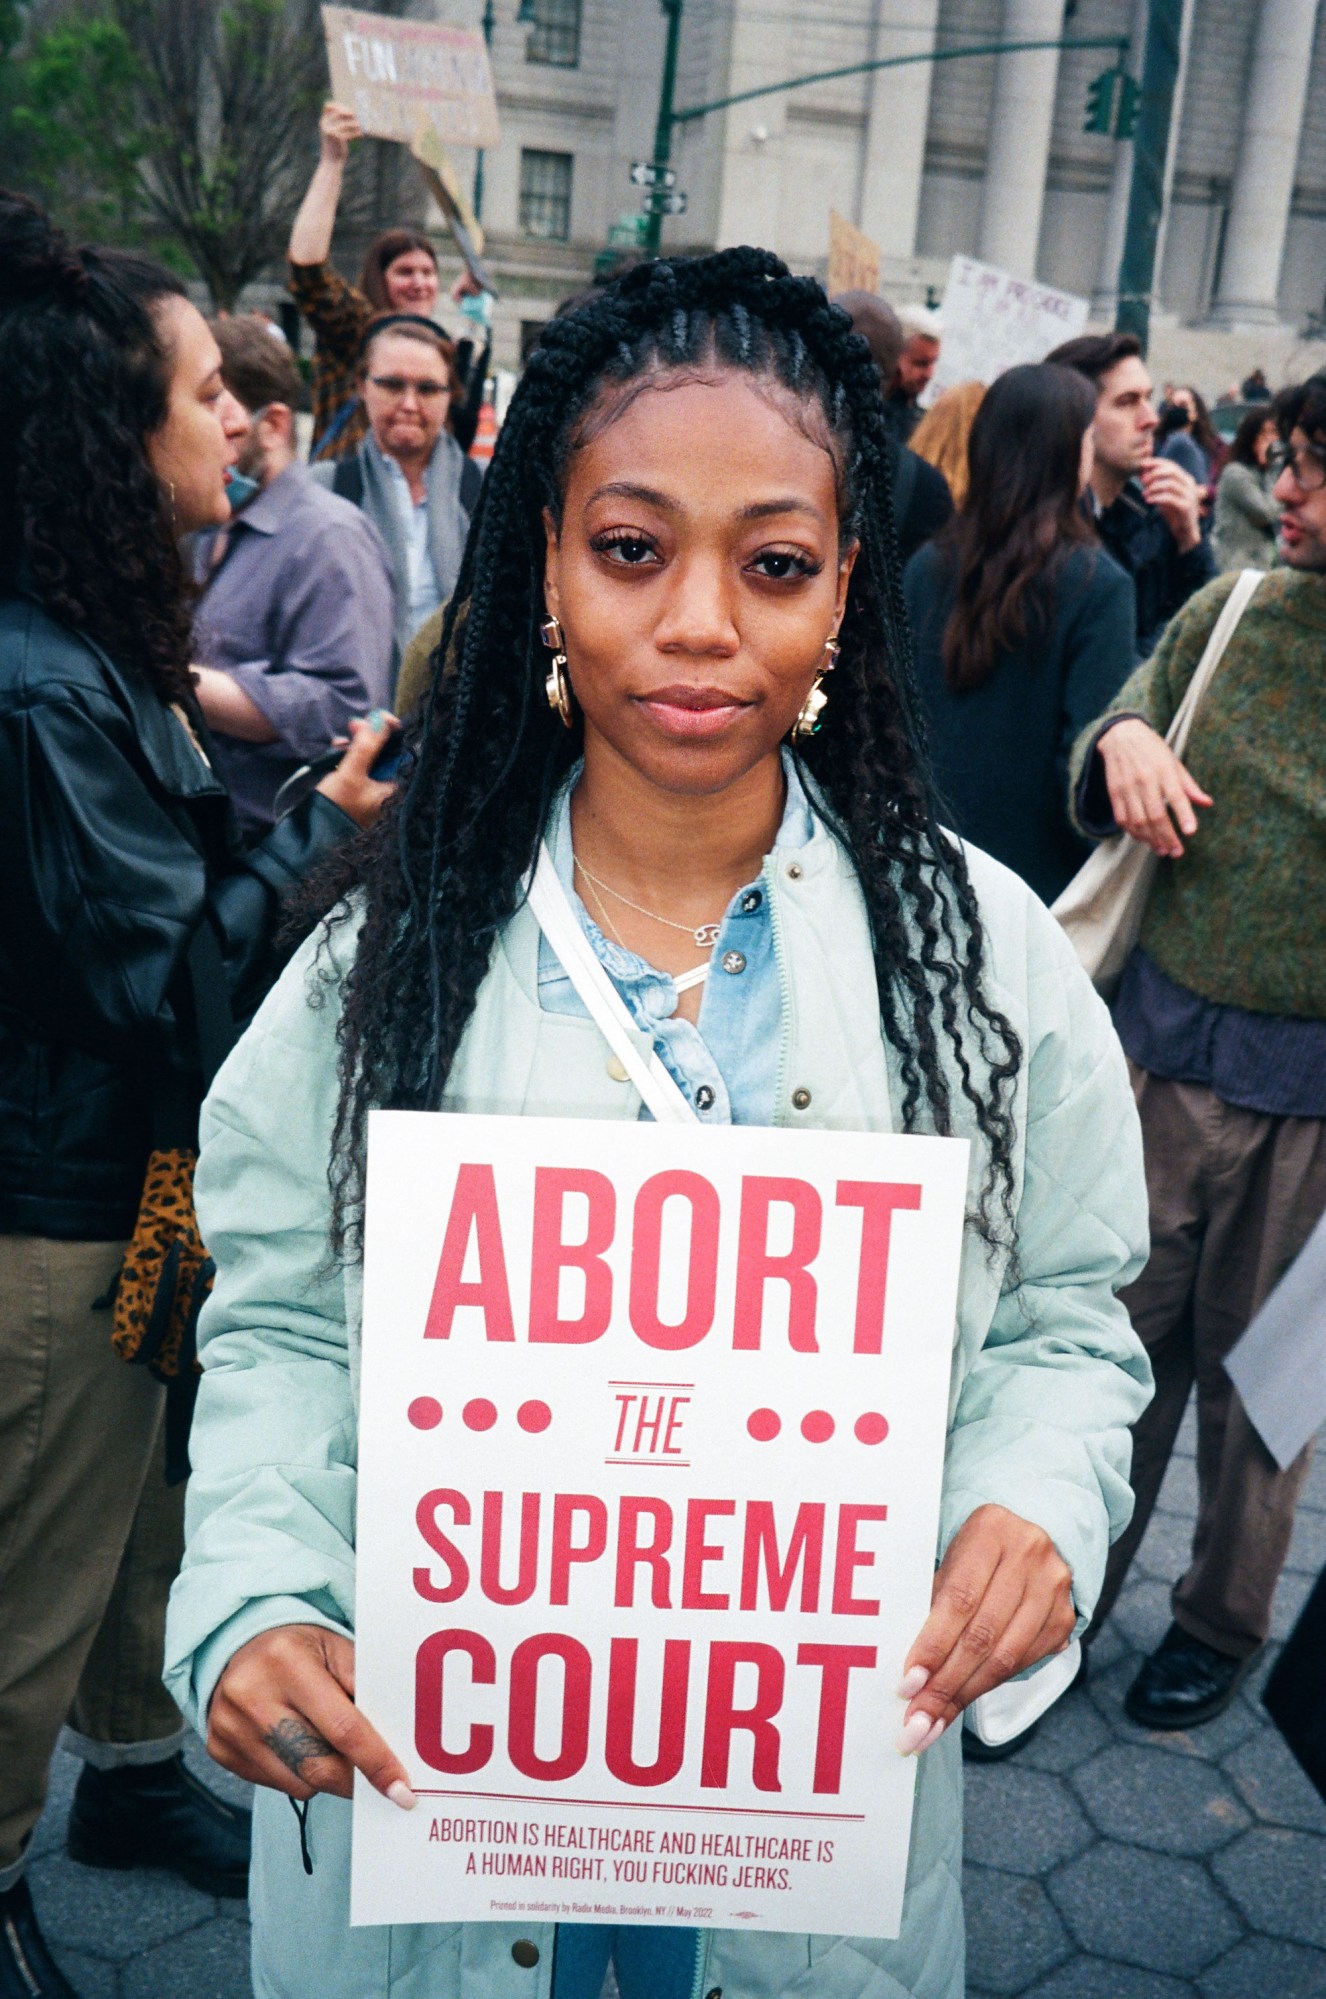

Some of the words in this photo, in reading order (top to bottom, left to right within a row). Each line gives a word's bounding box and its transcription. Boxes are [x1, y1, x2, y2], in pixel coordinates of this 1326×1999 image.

[424, 1163, 922, 1354] ABORT
[615, 1395, 691, 1454] THE
[413, 1488, 888, 1616] SUPREME
[413, 1628, 878, 1795] COURT
[429, 1818, 517, 1844] ABORTION
[523, 1822, 539, 1846] IS
[544, 1824, 655, 1854] HEALTHCARE
[660, 1831, 696, 1855] AND
[701, 1834, 813, 1862] HEALTHCARE
[817, 1840, 834, 1863] IS
[466, 1852, 477, 1875] A
[482, 1852, 547, 1877] HUMAN
[552, 1856, 607, 1883] RIGHT,
[613, 1860, 648, 1883] YOU
[653, 1861, 728, 1887] FUCKING
[732, 1866, 793, 1891] JERKS.
[490, 1899, 517, 1911] Printed
[519, 1901, 526, 1911] in
[527, 1901, 560, 1914] solidarity
[562, 1901, 571, 1914] by
[572, 1902, 592, 1913] Radix
[655, 1905, 666, 1915] NY
[676, 1906, 692, 1919] May
[693, 1907, 713, 1918] 2022
